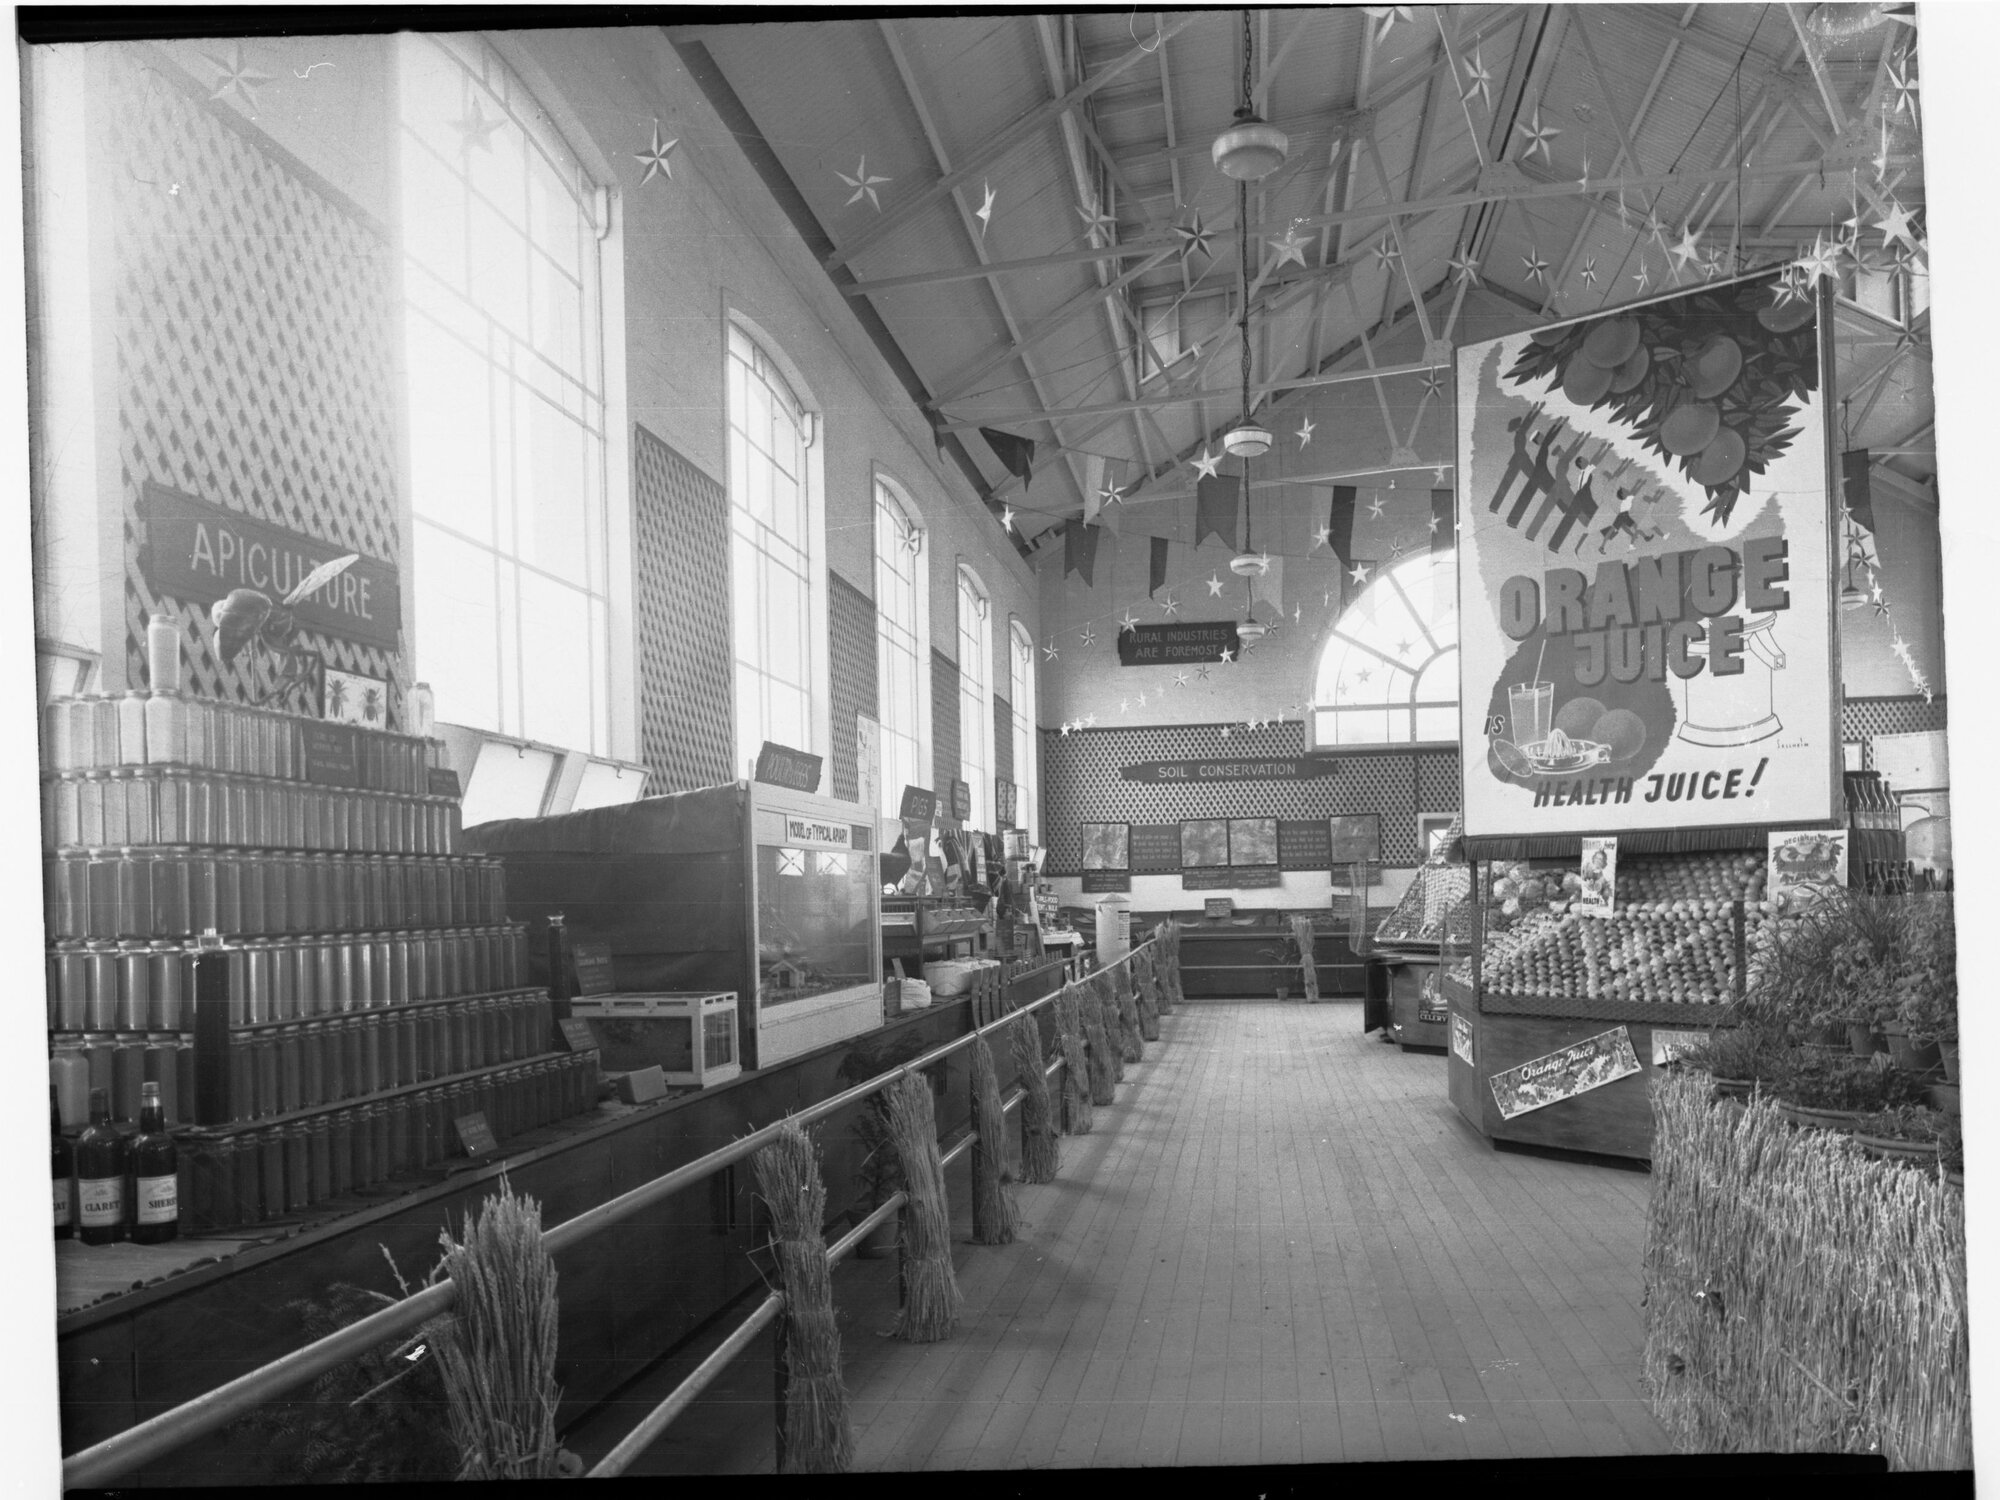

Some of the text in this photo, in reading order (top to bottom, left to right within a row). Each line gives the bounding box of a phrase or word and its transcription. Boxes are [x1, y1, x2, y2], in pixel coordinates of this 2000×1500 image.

[1500, 536, 1790, 641] ORANGE
[1129, 629, 1228, 643] RURAL INDUSTRIES
[1135, 644, 1218, 658] ARE FOREMOST
[1573, 615, 1744, 687] JUICE
[1483, 714, 1506, 735] IS
[1158, 763, 1296, 778] SOIL CONSERVATION
[1533, 756, 1770, 808] HEALTH JUICE!
[789, 820, 806, 839] MODEL
[812, 824, 832, 842] TYPICAL
[832, 827, 848, 843] APIARY
[1521, 1057, 1565, 1081] Orange
[1565, 1045, 1596, 1066] Juice
[85, 1200, 121, 1212] CLARET
